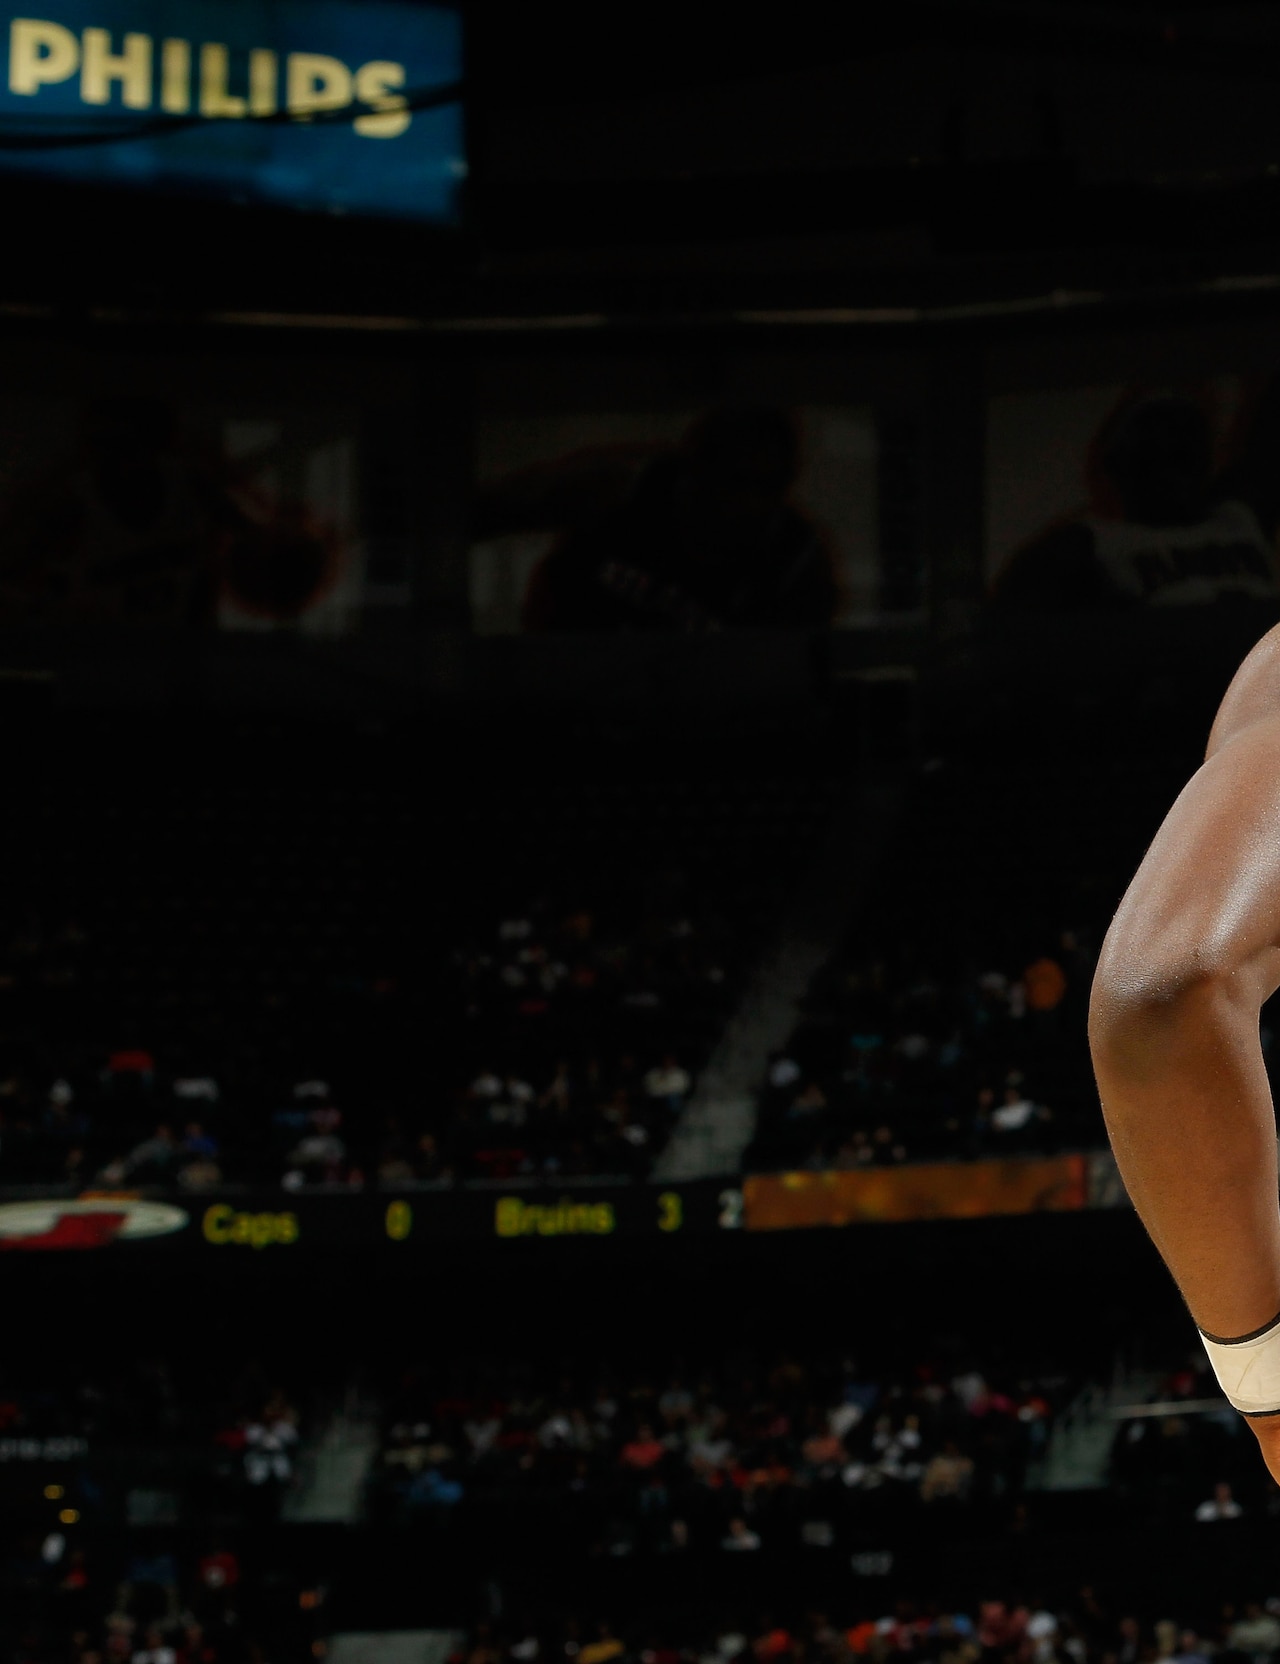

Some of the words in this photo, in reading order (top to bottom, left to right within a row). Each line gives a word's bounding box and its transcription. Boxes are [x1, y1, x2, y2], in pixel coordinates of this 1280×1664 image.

[8, 16, 413, 140] PHILIPS
[202, 1203, 300, 1249] Caps
[385, 1199, 413, 1241] 0
[495, 1195, 615, 1238] Bruins
[656, 1190, 683, 1233] 3
